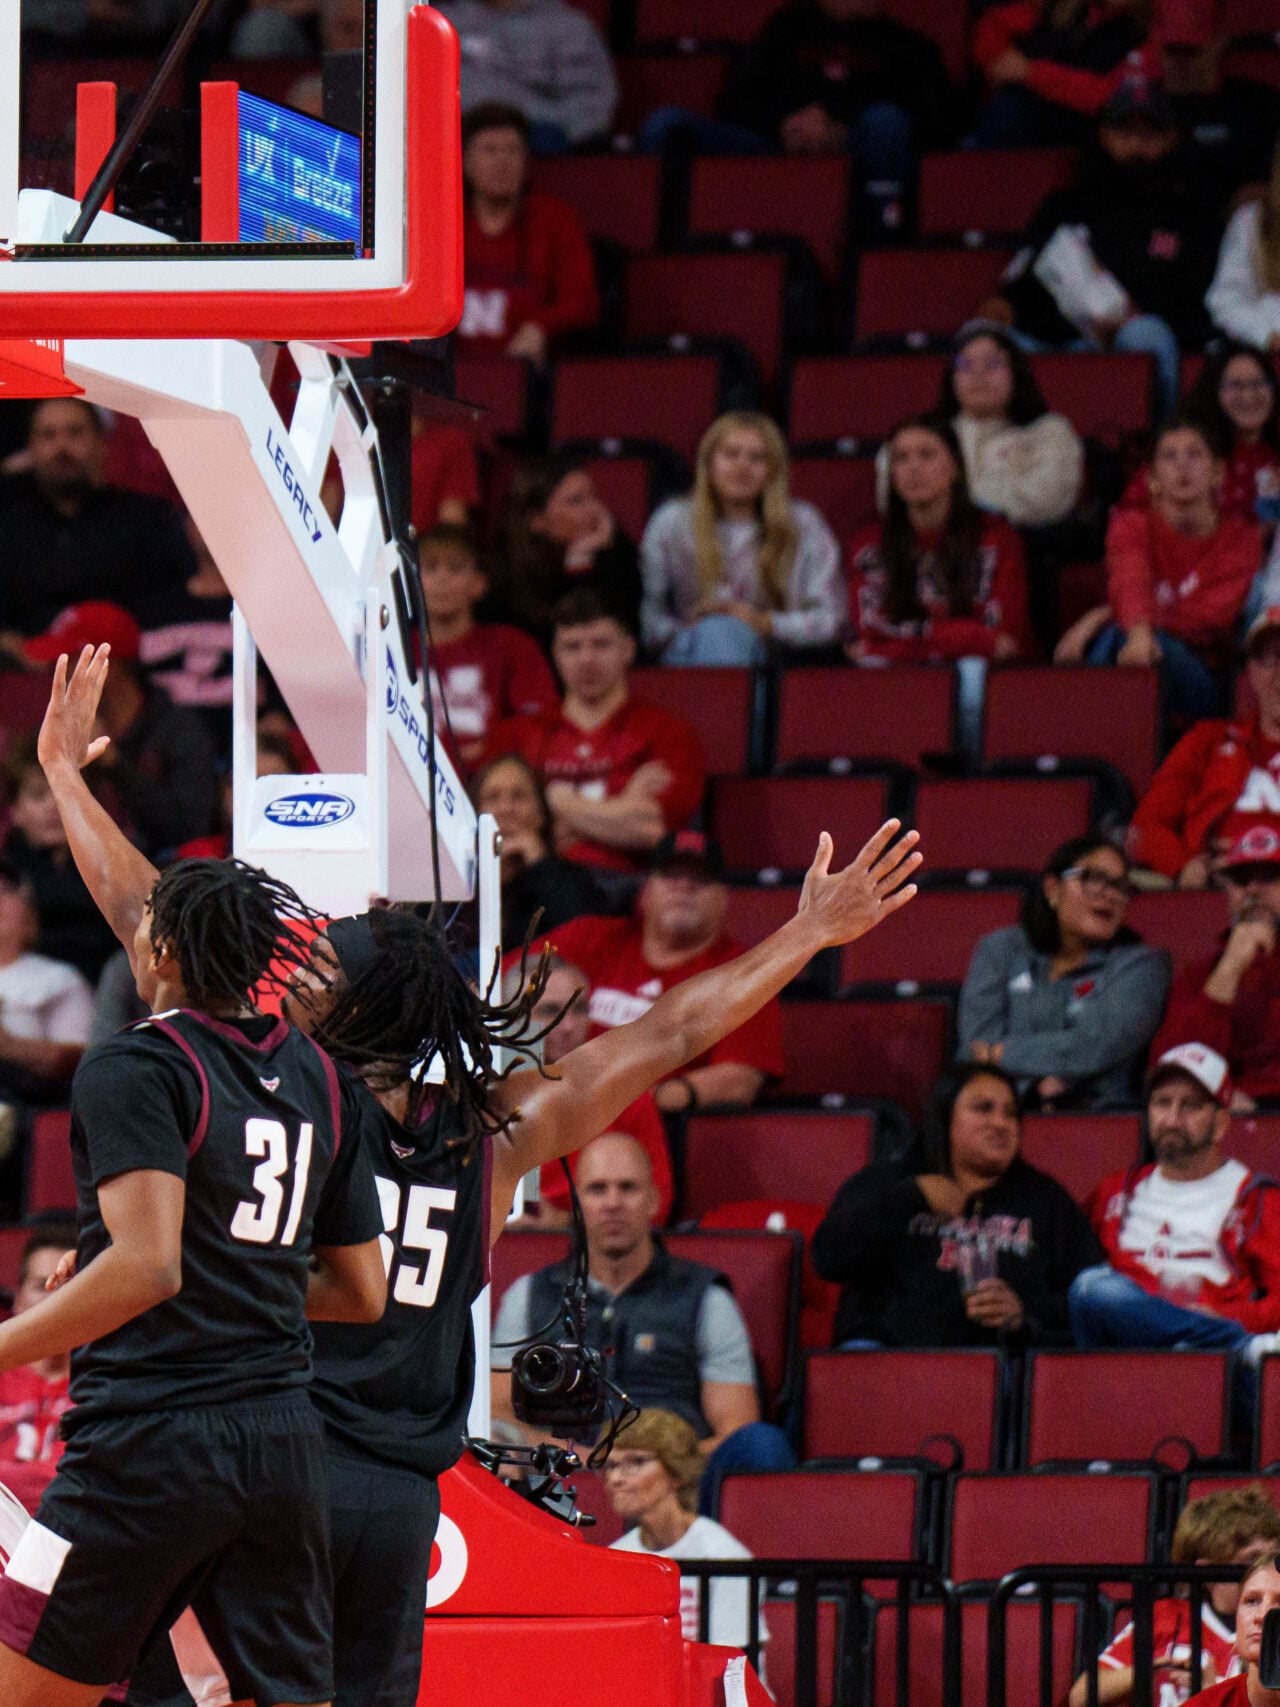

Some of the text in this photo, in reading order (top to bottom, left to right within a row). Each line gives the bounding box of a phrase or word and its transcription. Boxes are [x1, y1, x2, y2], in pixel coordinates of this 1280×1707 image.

[265, 426, 322, 543] LEGACY
[265, 800, 349, 817] SNA
[398, 695, 456, 817] SPOTS
[277, 815, 334, 823] SPORTS
[230, 1117, 314, 1246] 31
